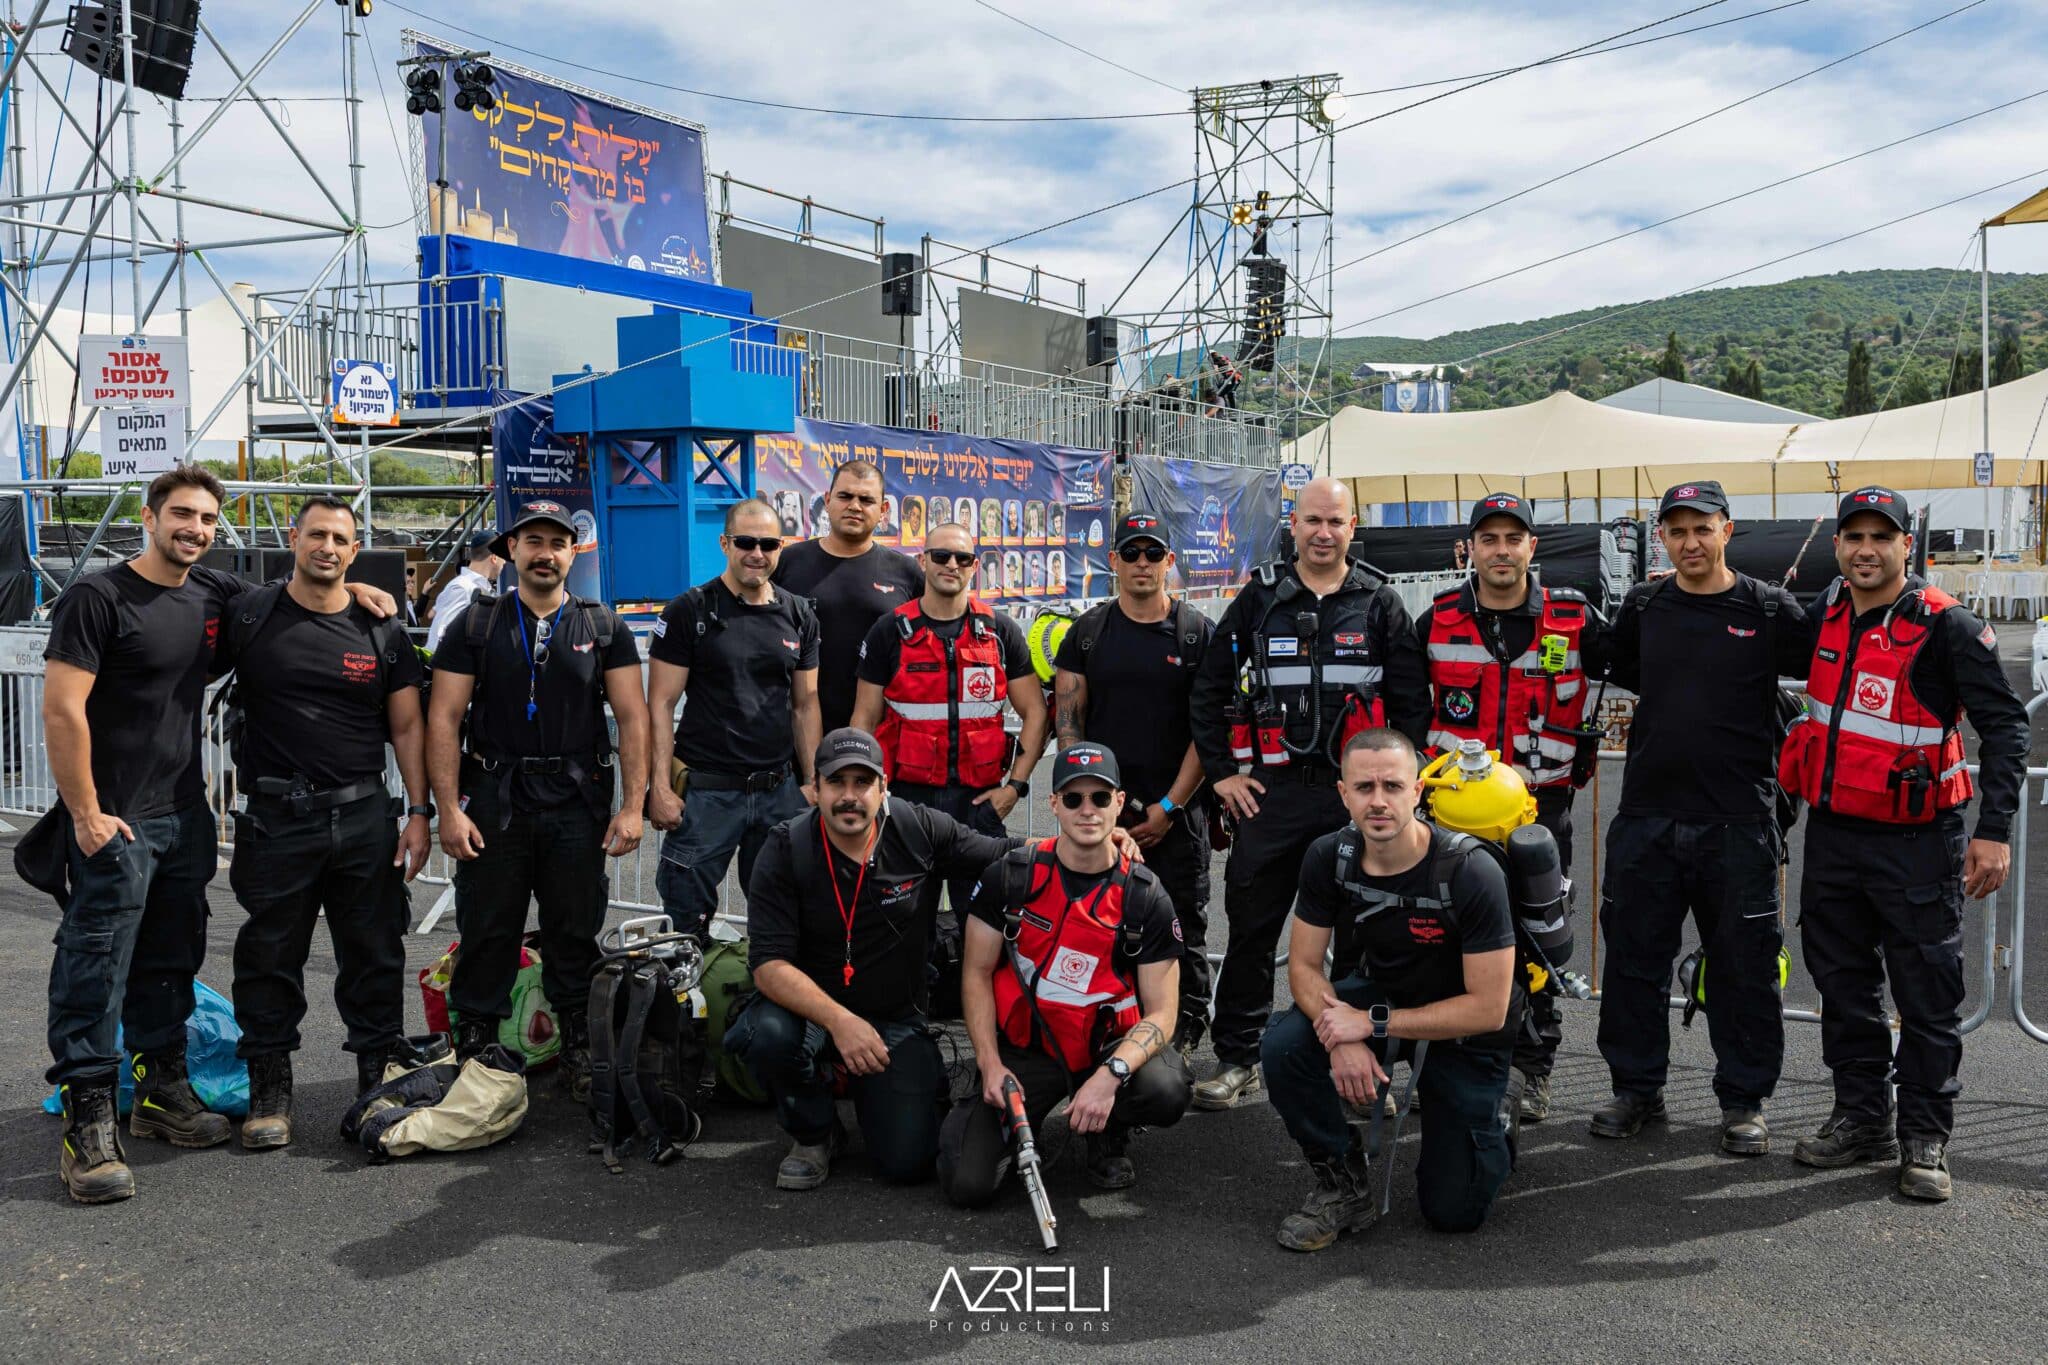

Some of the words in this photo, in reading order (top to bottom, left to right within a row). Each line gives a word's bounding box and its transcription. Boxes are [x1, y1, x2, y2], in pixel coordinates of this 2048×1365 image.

[108, 352, 161, 367] אסור
[102, 367, 169, 384] לטפס!
[360, 375, 372, 385] נא
[142, 388, 174, 399] נישט
[342, 386, 356, 398] על
[357, 388, 389, 400] לשמור
[349, 400, 385, 414] הניקיון!
[117, 414, 166, 433] המקום
[118, 437, 167, 452] מתאים
[105, 461, 137, 475] איש.
